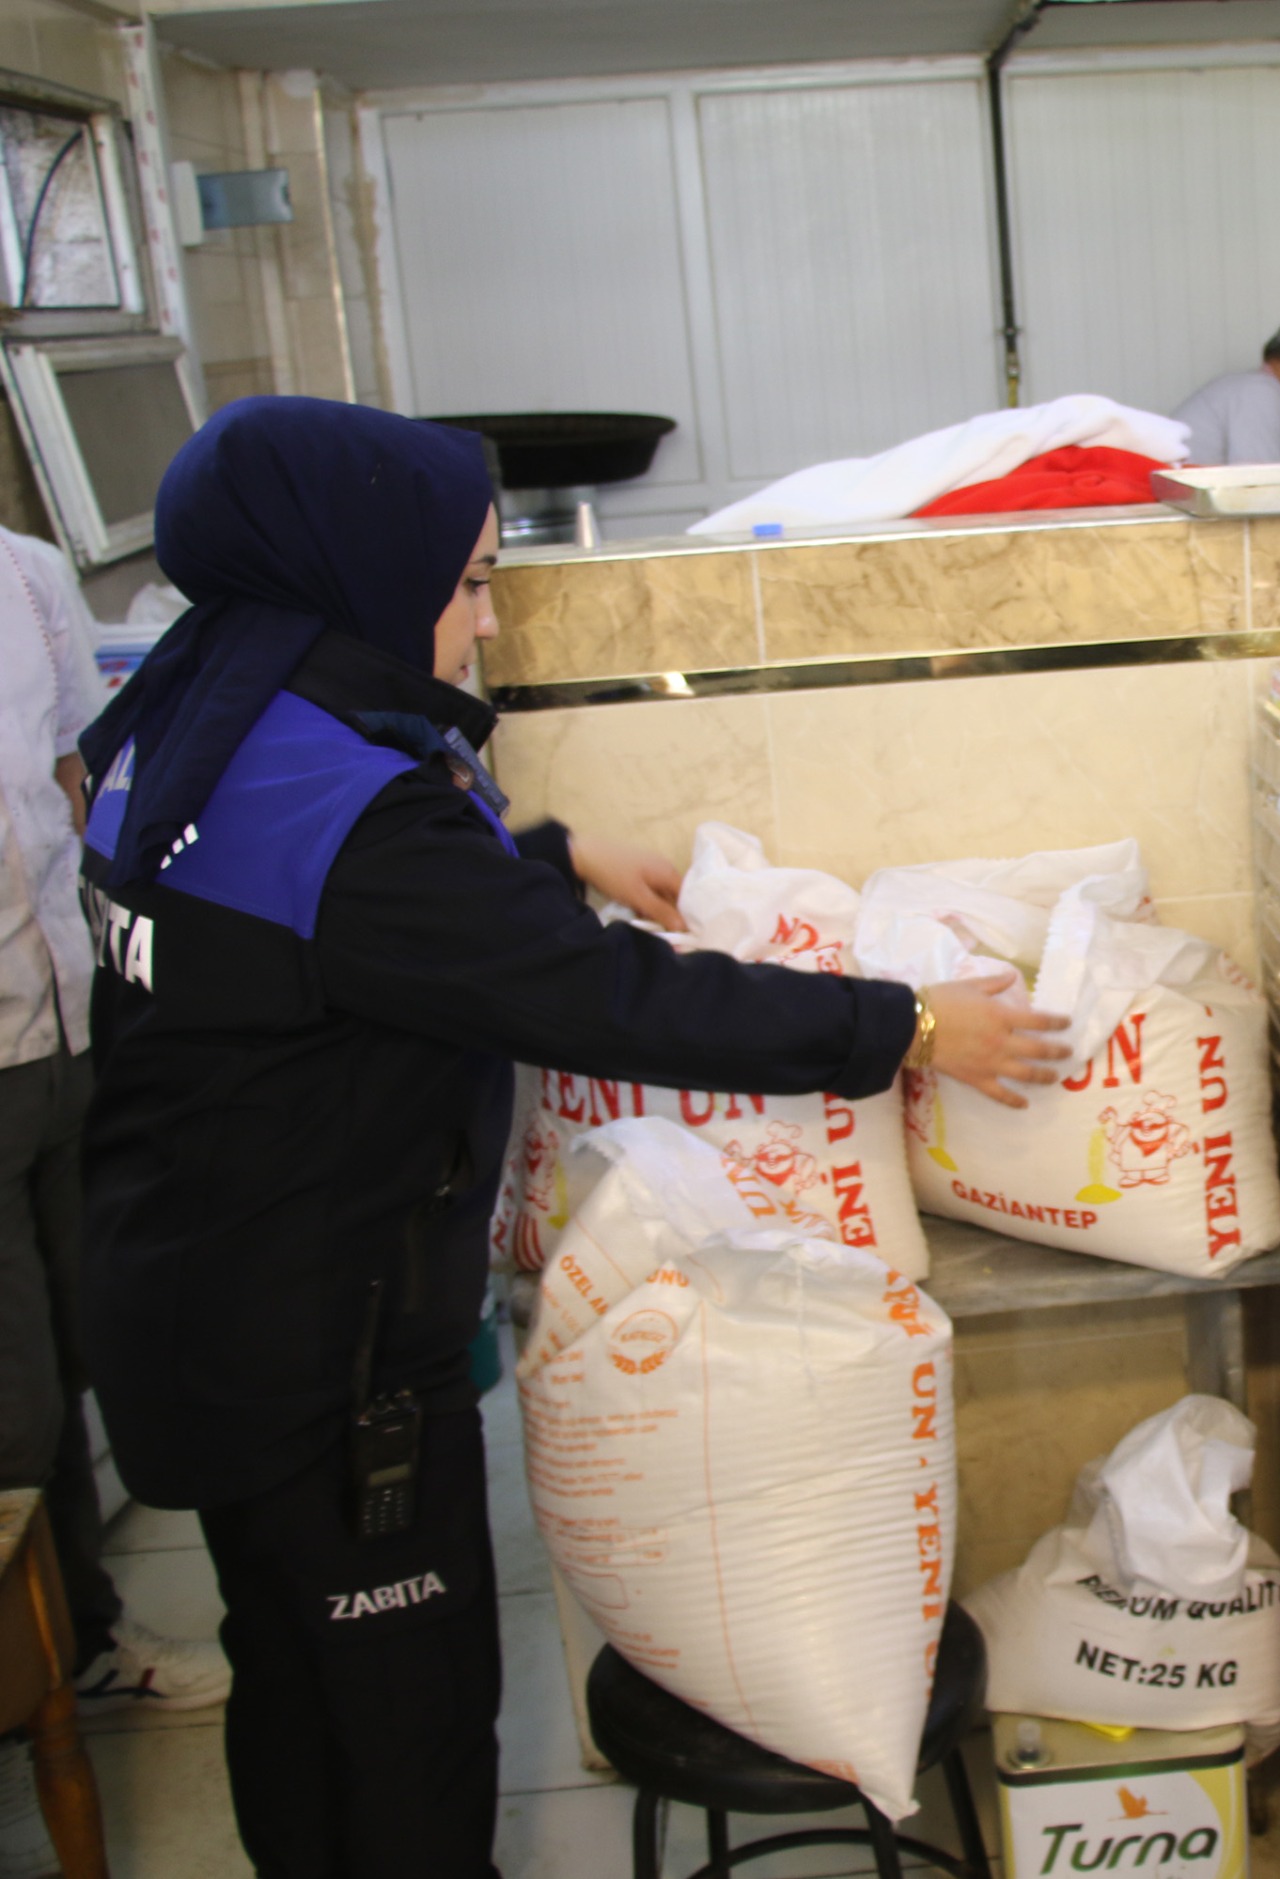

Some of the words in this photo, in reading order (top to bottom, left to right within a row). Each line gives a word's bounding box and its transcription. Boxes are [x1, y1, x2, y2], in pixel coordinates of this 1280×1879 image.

[1197, 1034, 1228, 1114] UN
[951, 1179, 1098, 1230] GAZİANTEP
[912, 1361, 938, 1441] UN
[328, 1571, 447, 1621] ZABITA
[1196, 1661, 1238, 1689] KG
[1039, 1823, 1220, 1876] Turna
